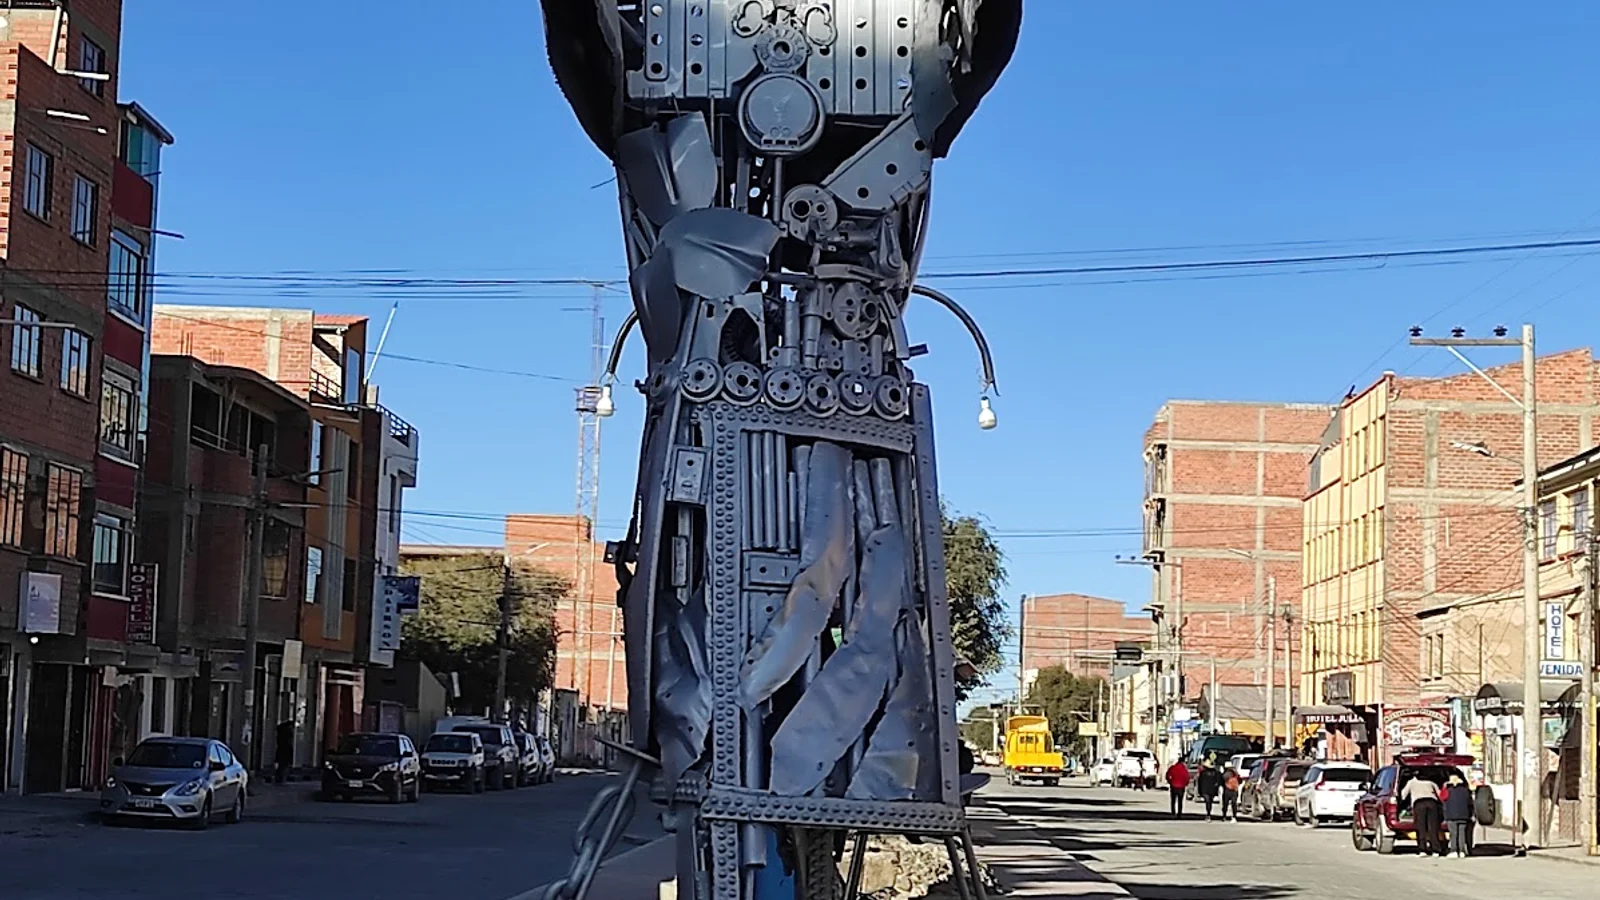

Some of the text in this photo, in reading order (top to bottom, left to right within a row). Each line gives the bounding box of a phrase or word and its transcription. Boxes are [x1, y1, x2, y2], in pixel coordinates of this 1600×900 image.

[131, 565, 145, 621] HOSTEL
[1551, 605, 1562, 657] HOTEL
[1306, 715, 1337, 723] HOTEL
